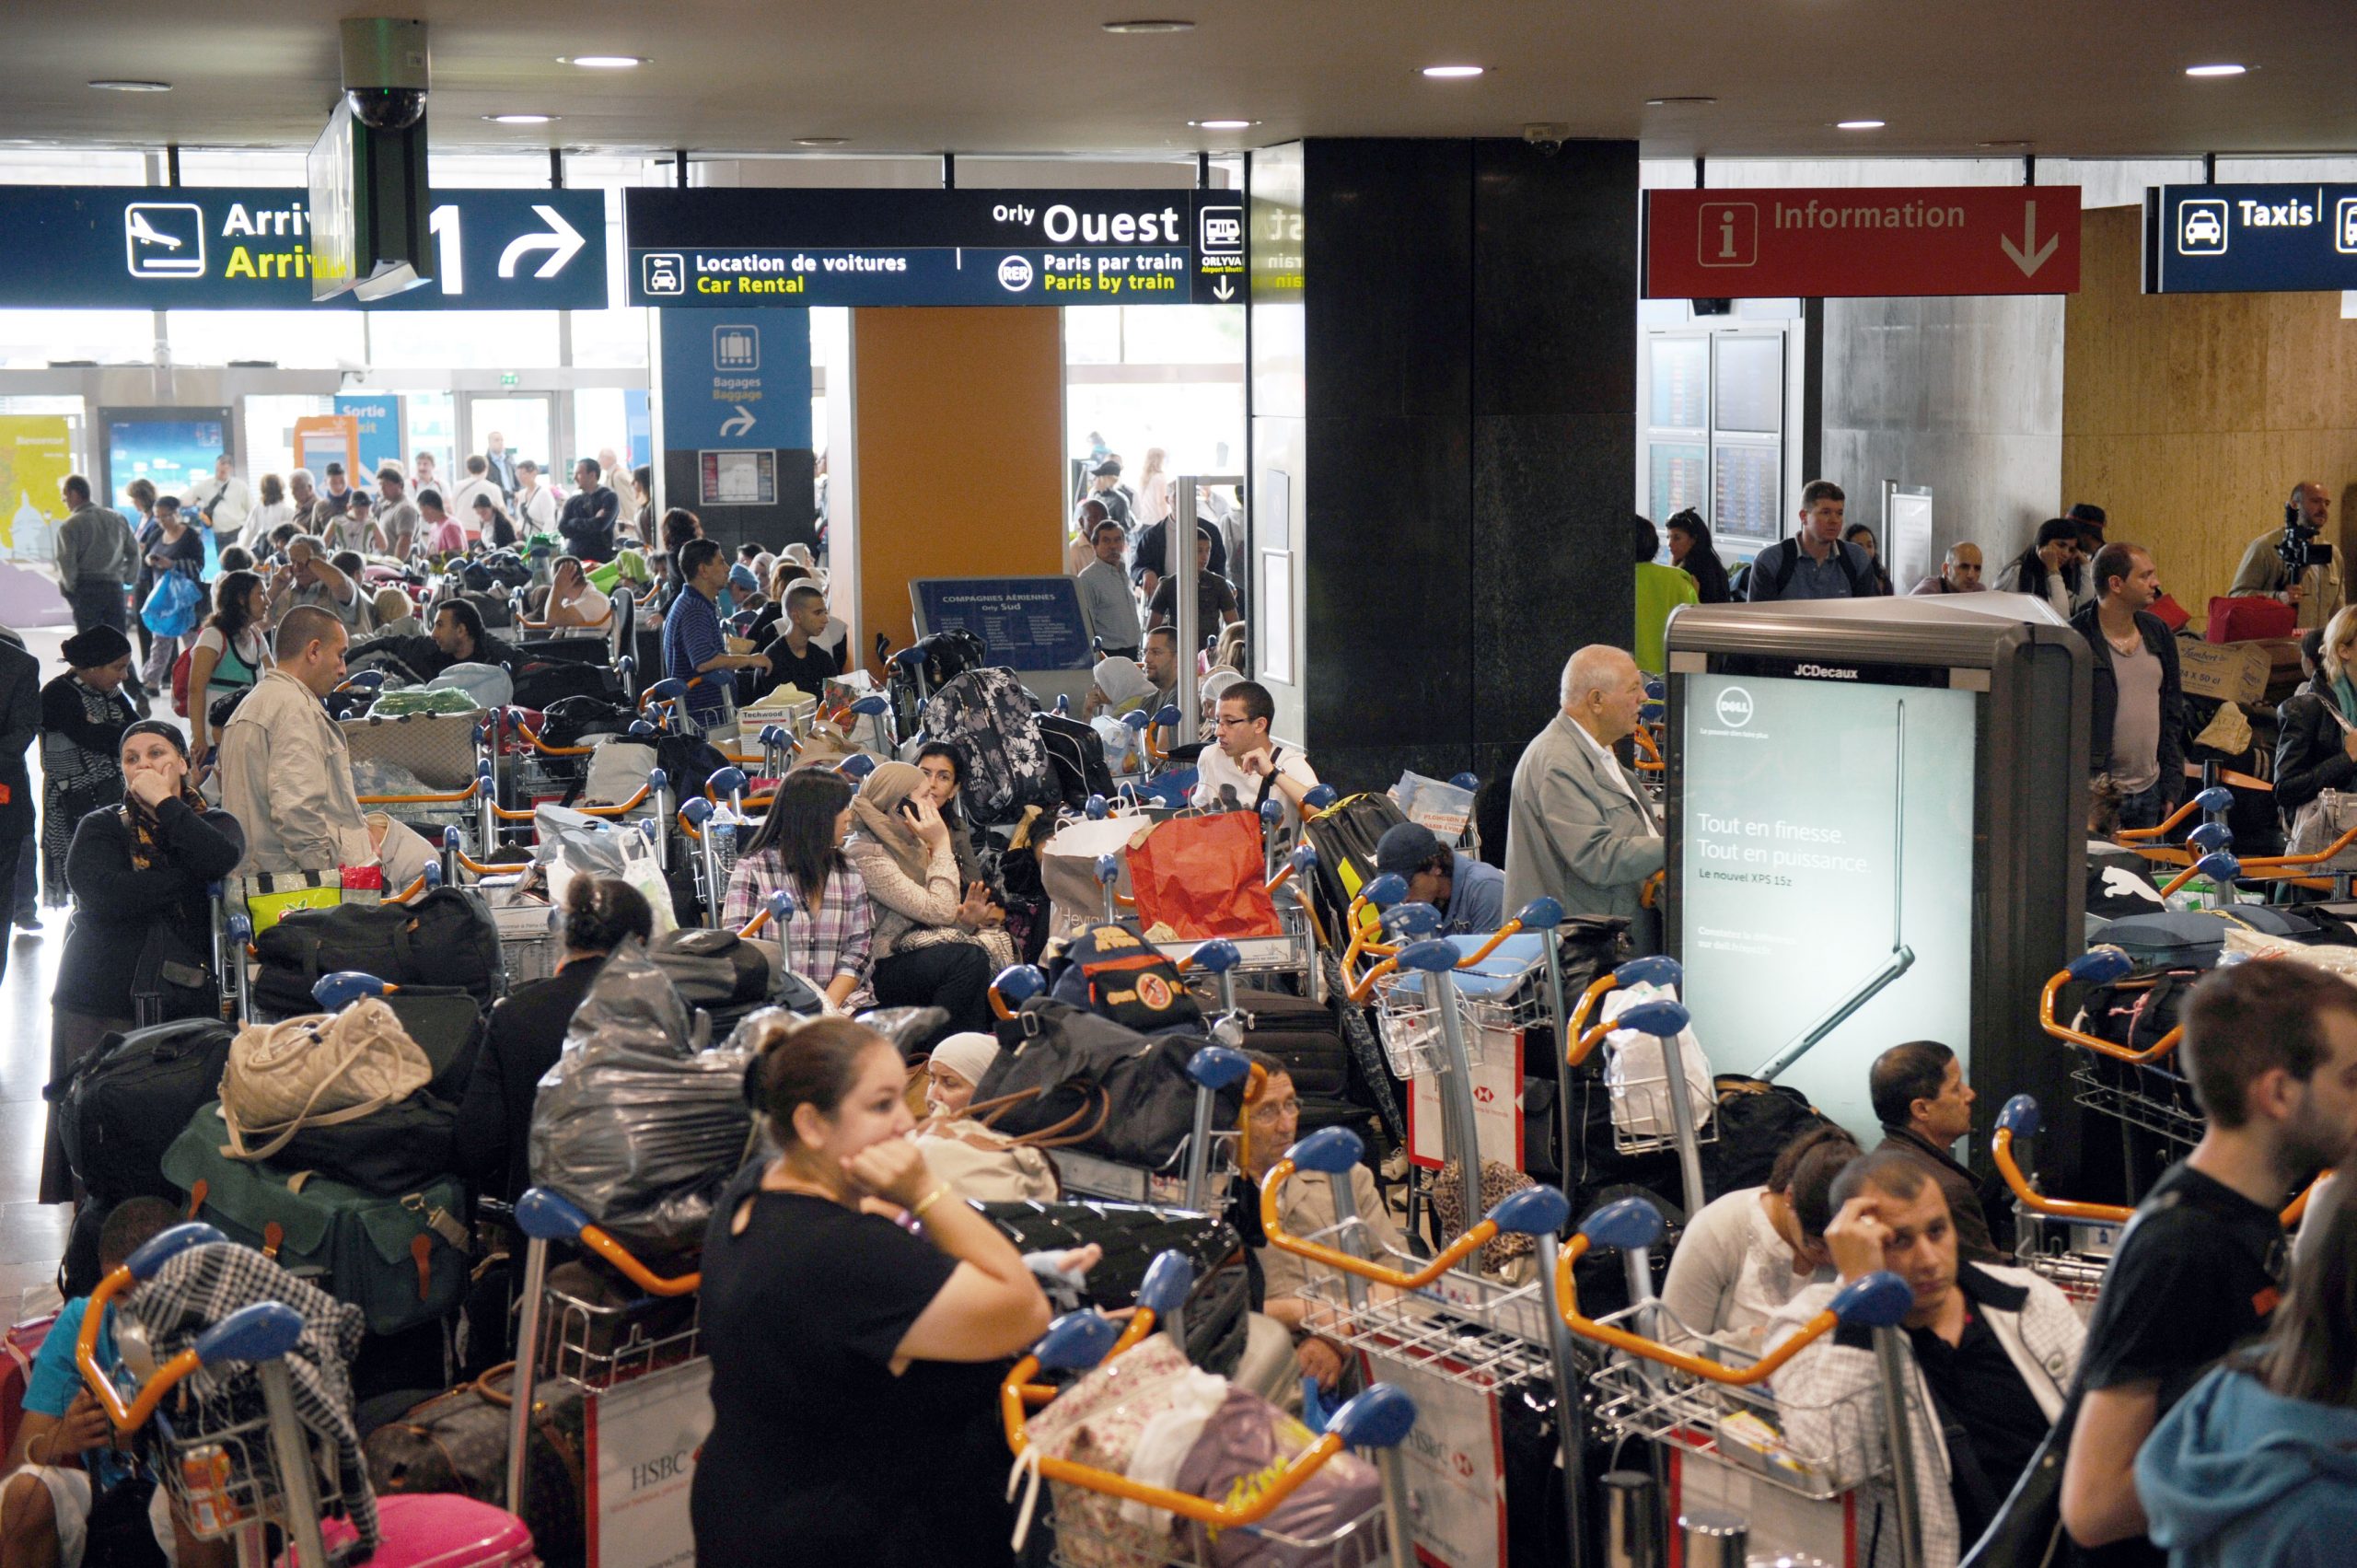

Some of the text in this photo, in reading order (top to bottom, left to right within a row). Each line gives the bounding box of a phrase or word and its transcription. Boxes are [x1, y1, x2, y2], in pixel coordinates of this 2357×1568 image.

[1775, 200, 1965, 229] Information
[2238, 199, 2313, 226] Taxis
[993, 203, 1179, 242] Orly Ouest
[222, 203, 463, 295] Arri 1
[696, 254, 907, 273] Location de voitures
[1044, 253, 1183, 274] Paris par train
[1002, 265, 1028, 281] RER
[697, 276, 804, 294] Car Rental
[1044, 273, 1175, 294] Paris by train
[713, 377, 761, 389] Bagages
[713, 389, 762, 401] Baggage
[342, 404, 386, 418] Sortie
[358, 422, 377, 434] xit
[942, 592, 1056, 603] COMPAGNIES AÉRIENNES
[981, 602, 1021, 612] Orly Sud
[1794, 664, 1858, 679] JCDecaux
[2200, 673, 2211, 682] 50
[1721, 700, 1749, 713] DELL
[1697, 812, 1846, 844] Tout en finesse.
[1697, 839, 1872, 874] Tout en puissance.
[1699, 868, 1793, 887] Le nouvel XPS 15z
[632, 1450, 688, 1491] HSBC
